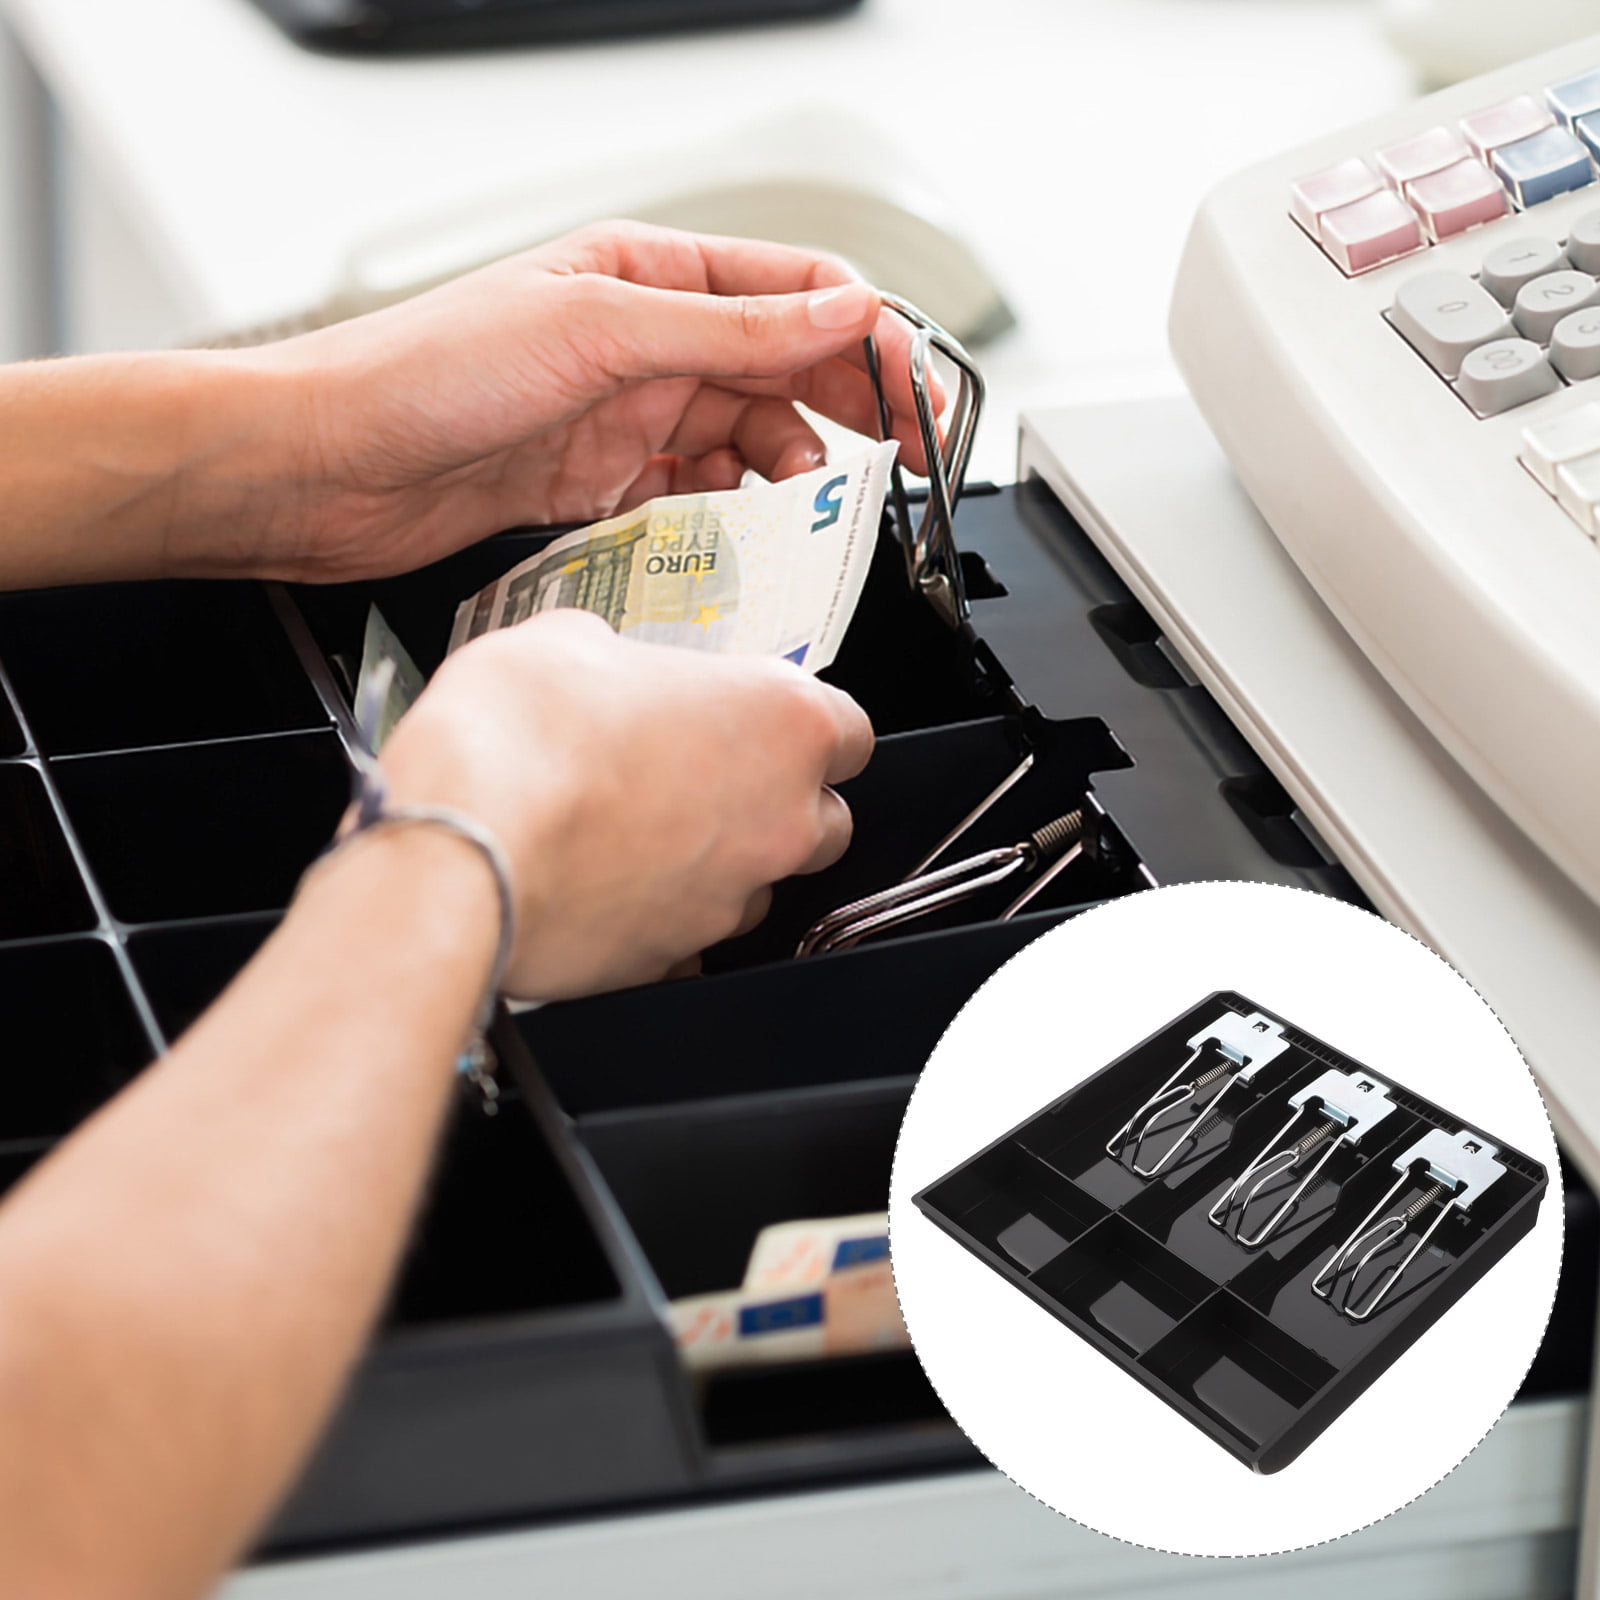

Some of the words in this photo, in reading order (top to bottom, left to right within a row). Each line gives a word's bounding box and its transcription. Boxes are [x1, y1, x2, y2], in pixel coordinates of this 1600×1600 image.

[1542, 284, 1575, 300] 2
[810, 474, 848, 534] 5
[646, 552, 717, 575] EURO
